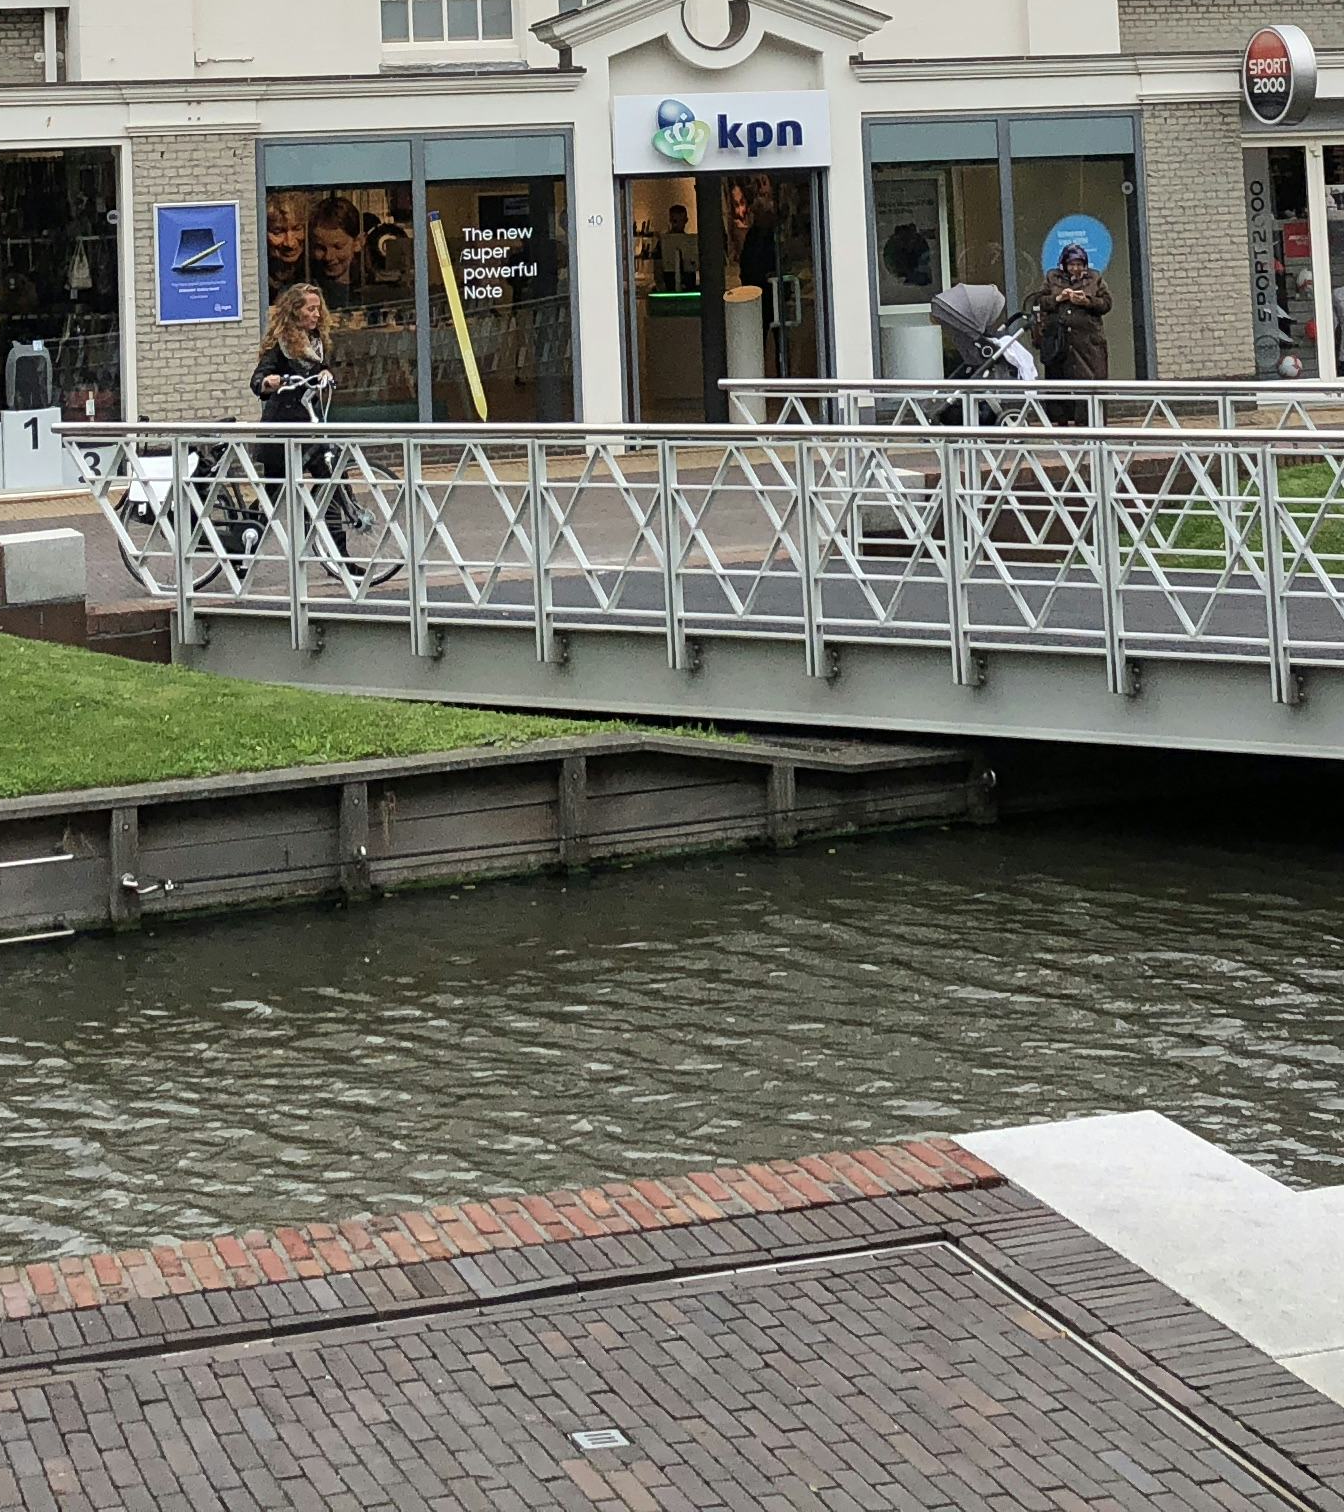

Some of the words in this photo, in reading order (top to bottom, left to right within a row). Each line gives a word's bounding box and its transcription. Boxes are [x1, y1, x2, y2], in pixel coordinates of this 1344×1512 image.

[1248, 57, 1288, 75] SPORT
[1252, 76, 1286, 94] 2000
[717, 113, 803, 158] kpn
[587, 214, 604, 227] 40
[462, 227, 494, 242] The
[496, 226, 533, 240] new
[462, 245, 511, 264] super
[463, 261, 538, 284] powerful
[463, 285, 504, 300] Note
[23, 416, 39, 450] 1
[78, 451, 102, 484] 3
